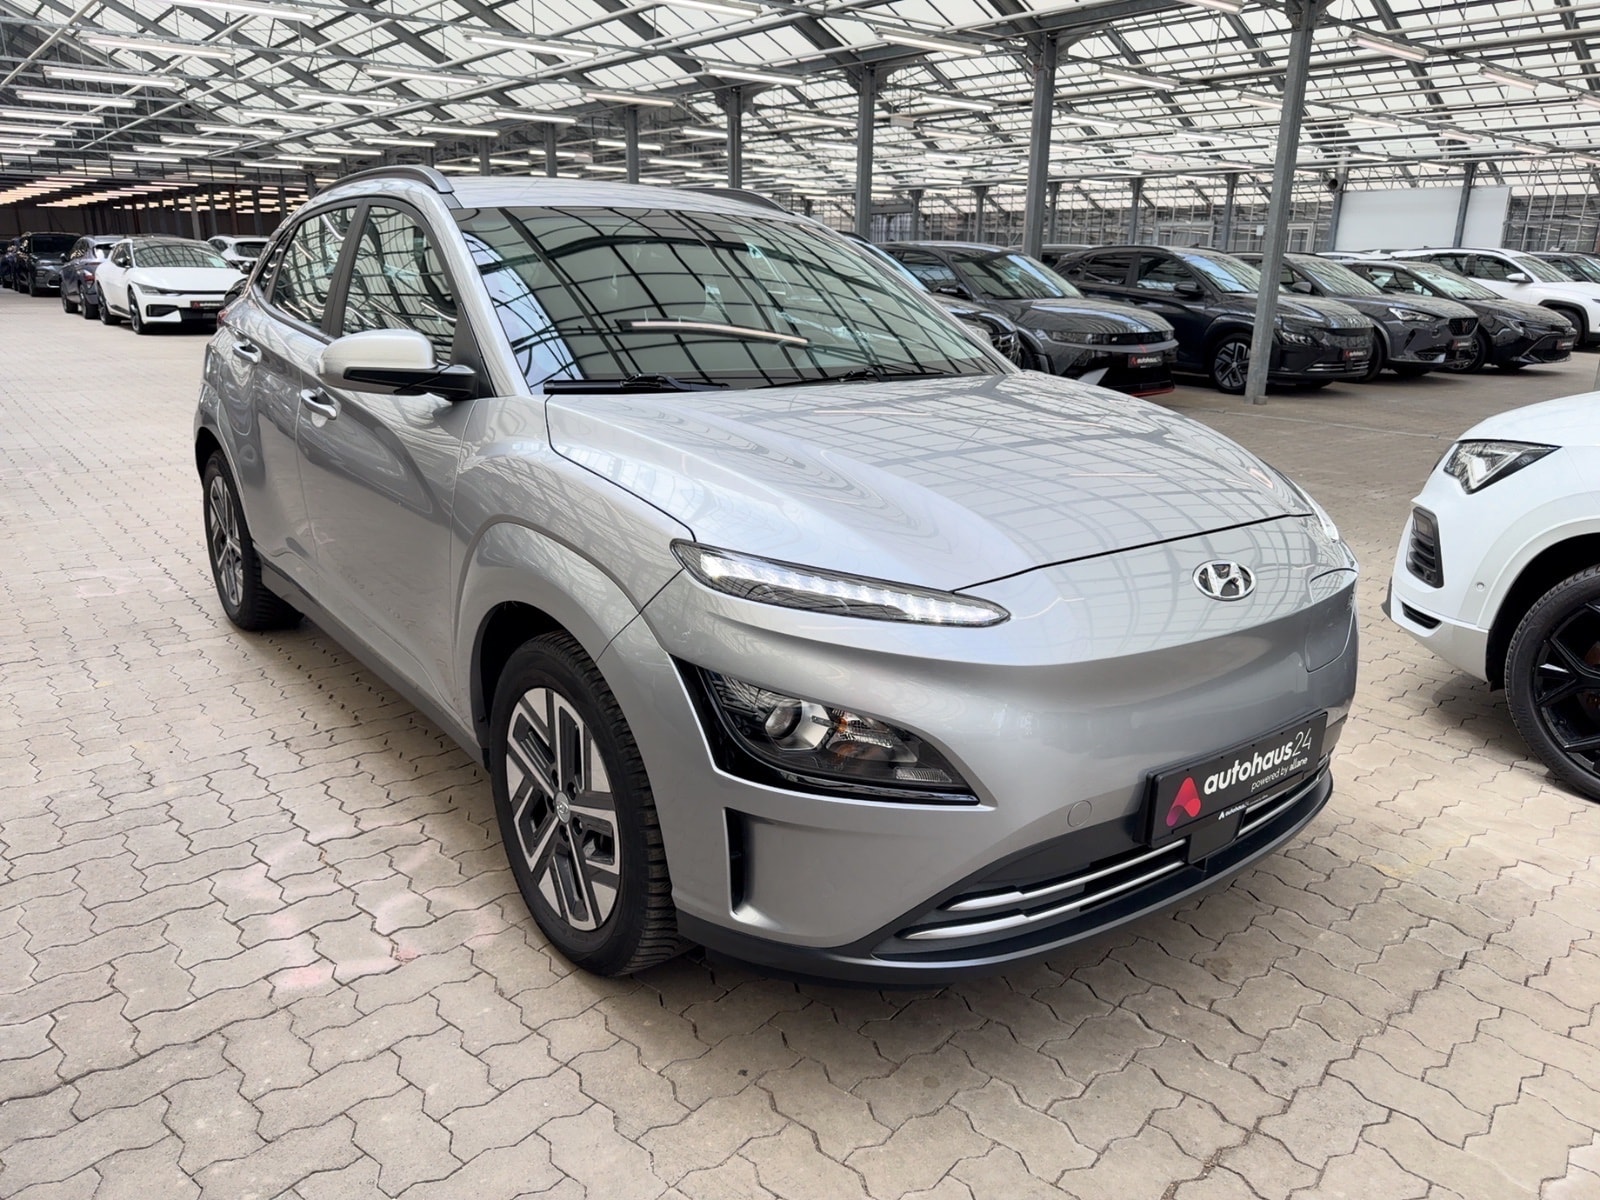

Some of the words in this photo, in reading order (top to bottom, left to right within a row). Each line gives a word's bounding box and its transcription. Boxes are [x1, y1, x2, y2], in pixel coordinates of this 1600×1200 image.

[1203, 727, 1312, 795] autohaus24
[1250, 767, 1281, 793] powered
[1280, 766, 1290, 777] by
